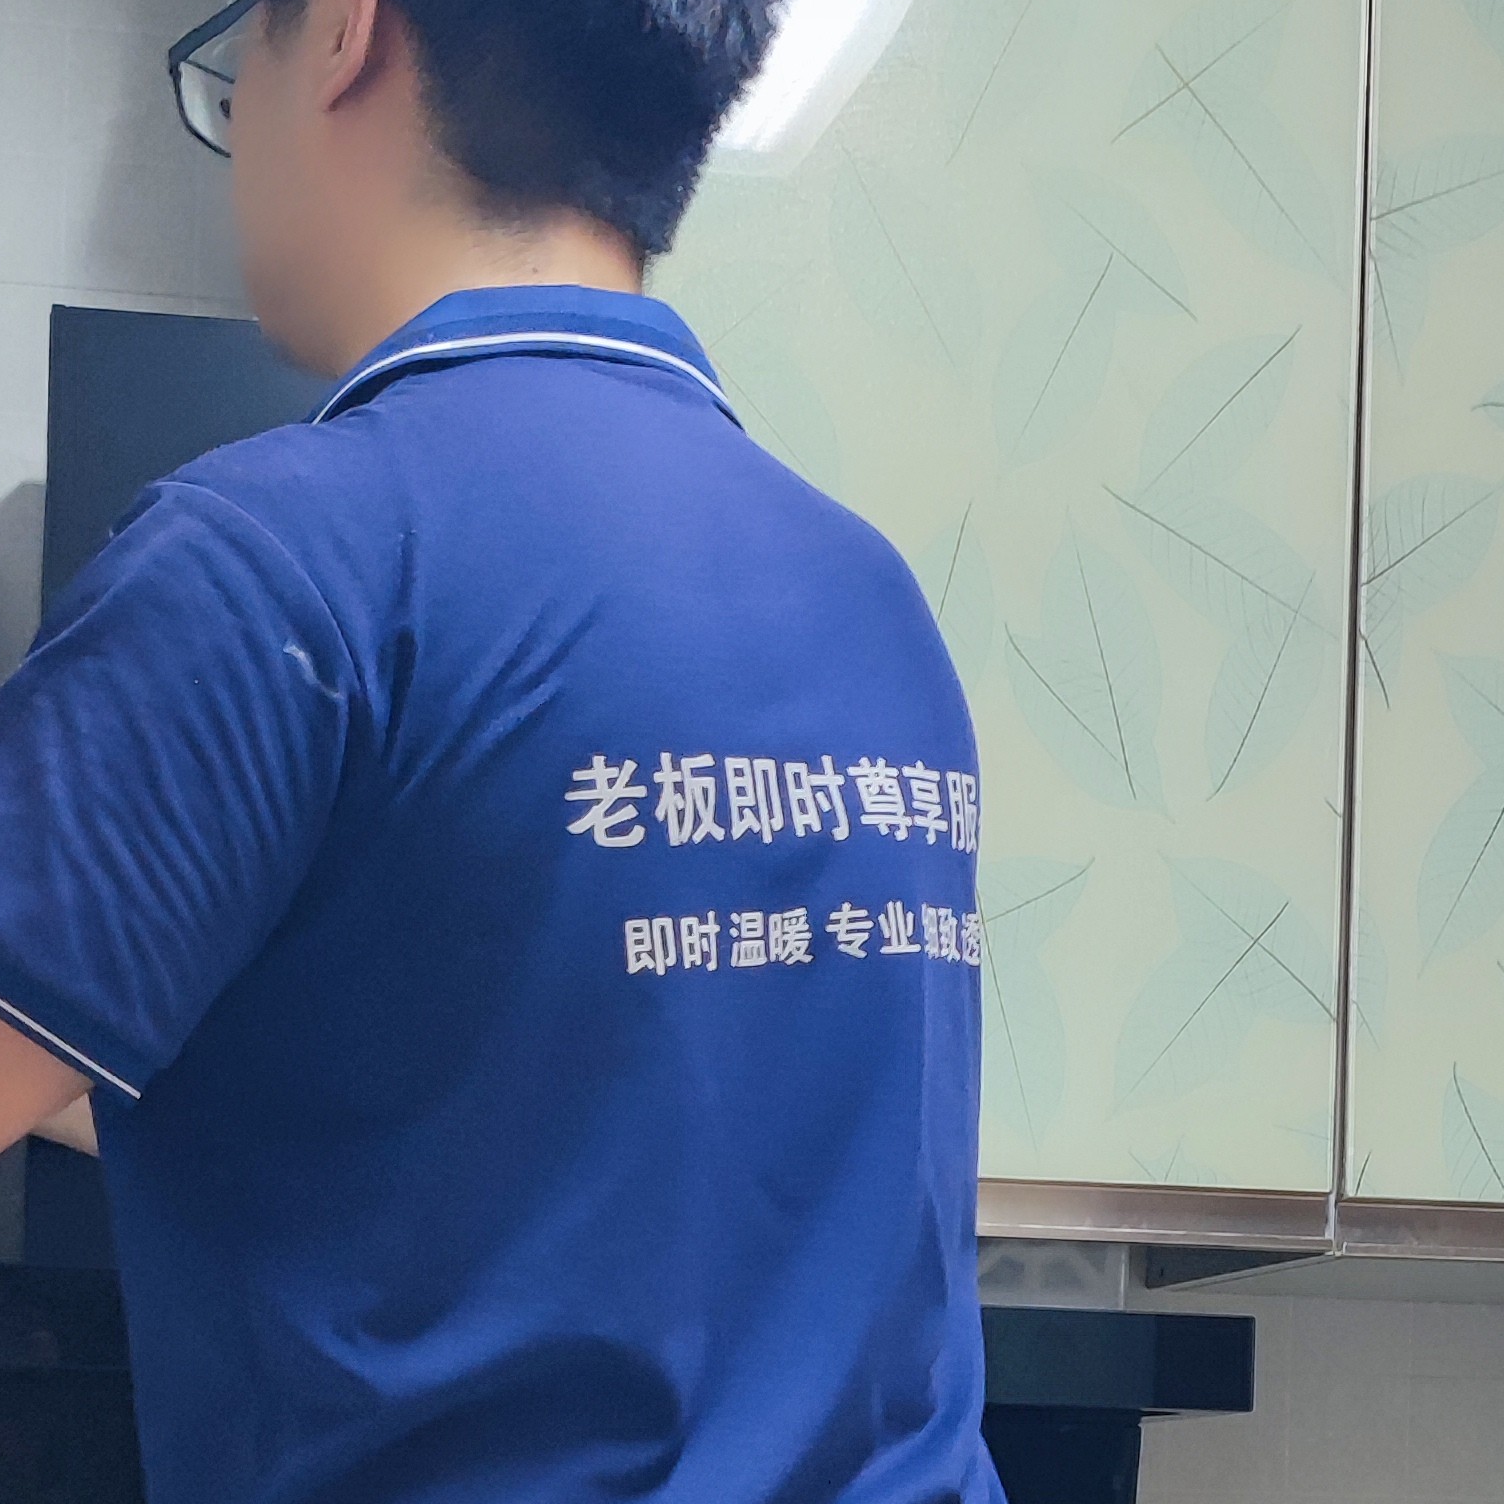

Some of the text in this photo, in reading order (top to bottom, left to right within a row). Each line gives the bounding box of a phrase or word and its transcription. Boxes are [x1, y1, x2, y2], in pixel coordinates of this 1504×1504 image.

[564, 752, 979, 854] 老板即时尊享服
[624, 907, 813, 976] 即时温暖
